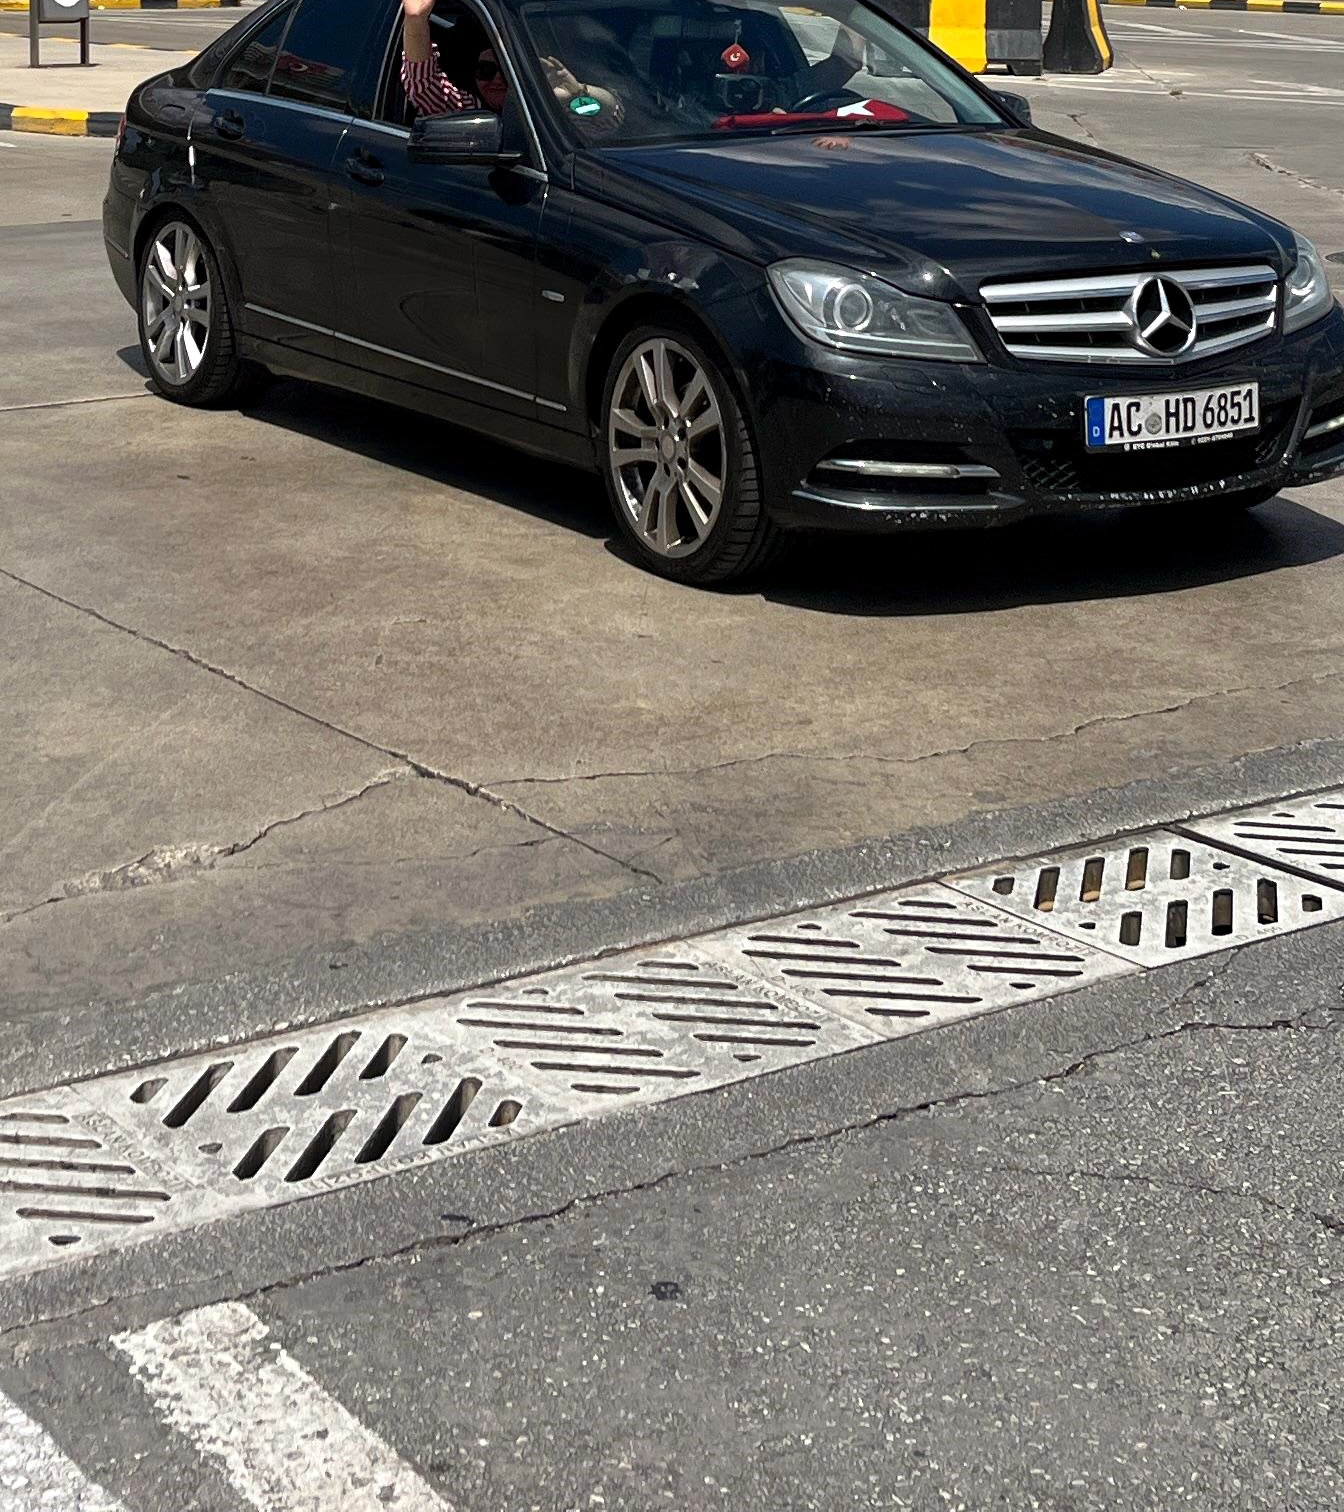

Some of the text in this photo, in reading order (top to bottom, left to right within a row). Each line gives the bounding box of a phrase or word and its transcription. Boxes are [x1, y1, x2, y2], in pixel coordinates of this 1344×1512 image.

[1108, 388, 1256, 439] AC HD 6851
[1092, 426, 1100, 438] D
